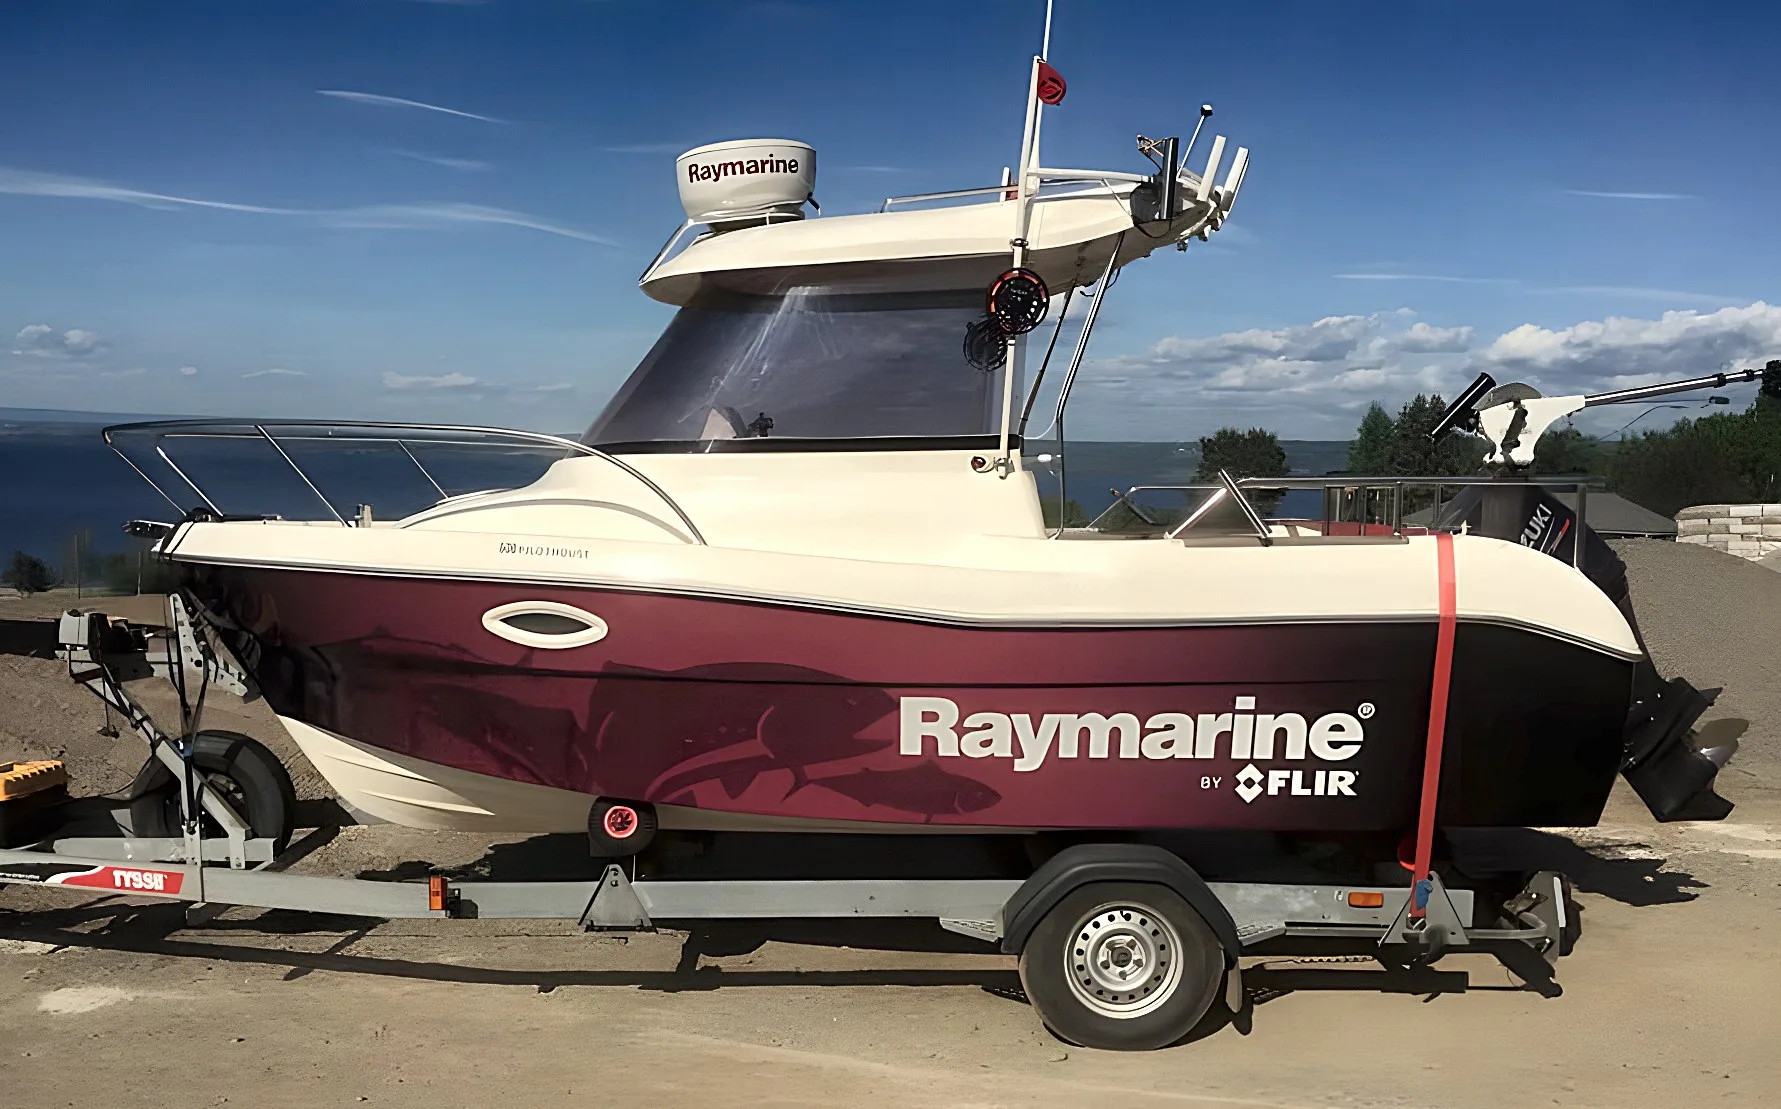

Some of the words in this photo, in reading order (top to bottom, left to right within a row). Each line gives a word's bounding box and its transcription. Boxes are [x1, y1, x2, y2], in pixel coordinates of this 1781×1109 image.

[688, 153, 799, 183] Raymarine
[1520, 503, 1552, 548] ZUKI
[899, 695, 1364, 772] Raymarine
[1200, 776, 1222, 789] BY
[1267, 770, 1358, 796] FLIR
